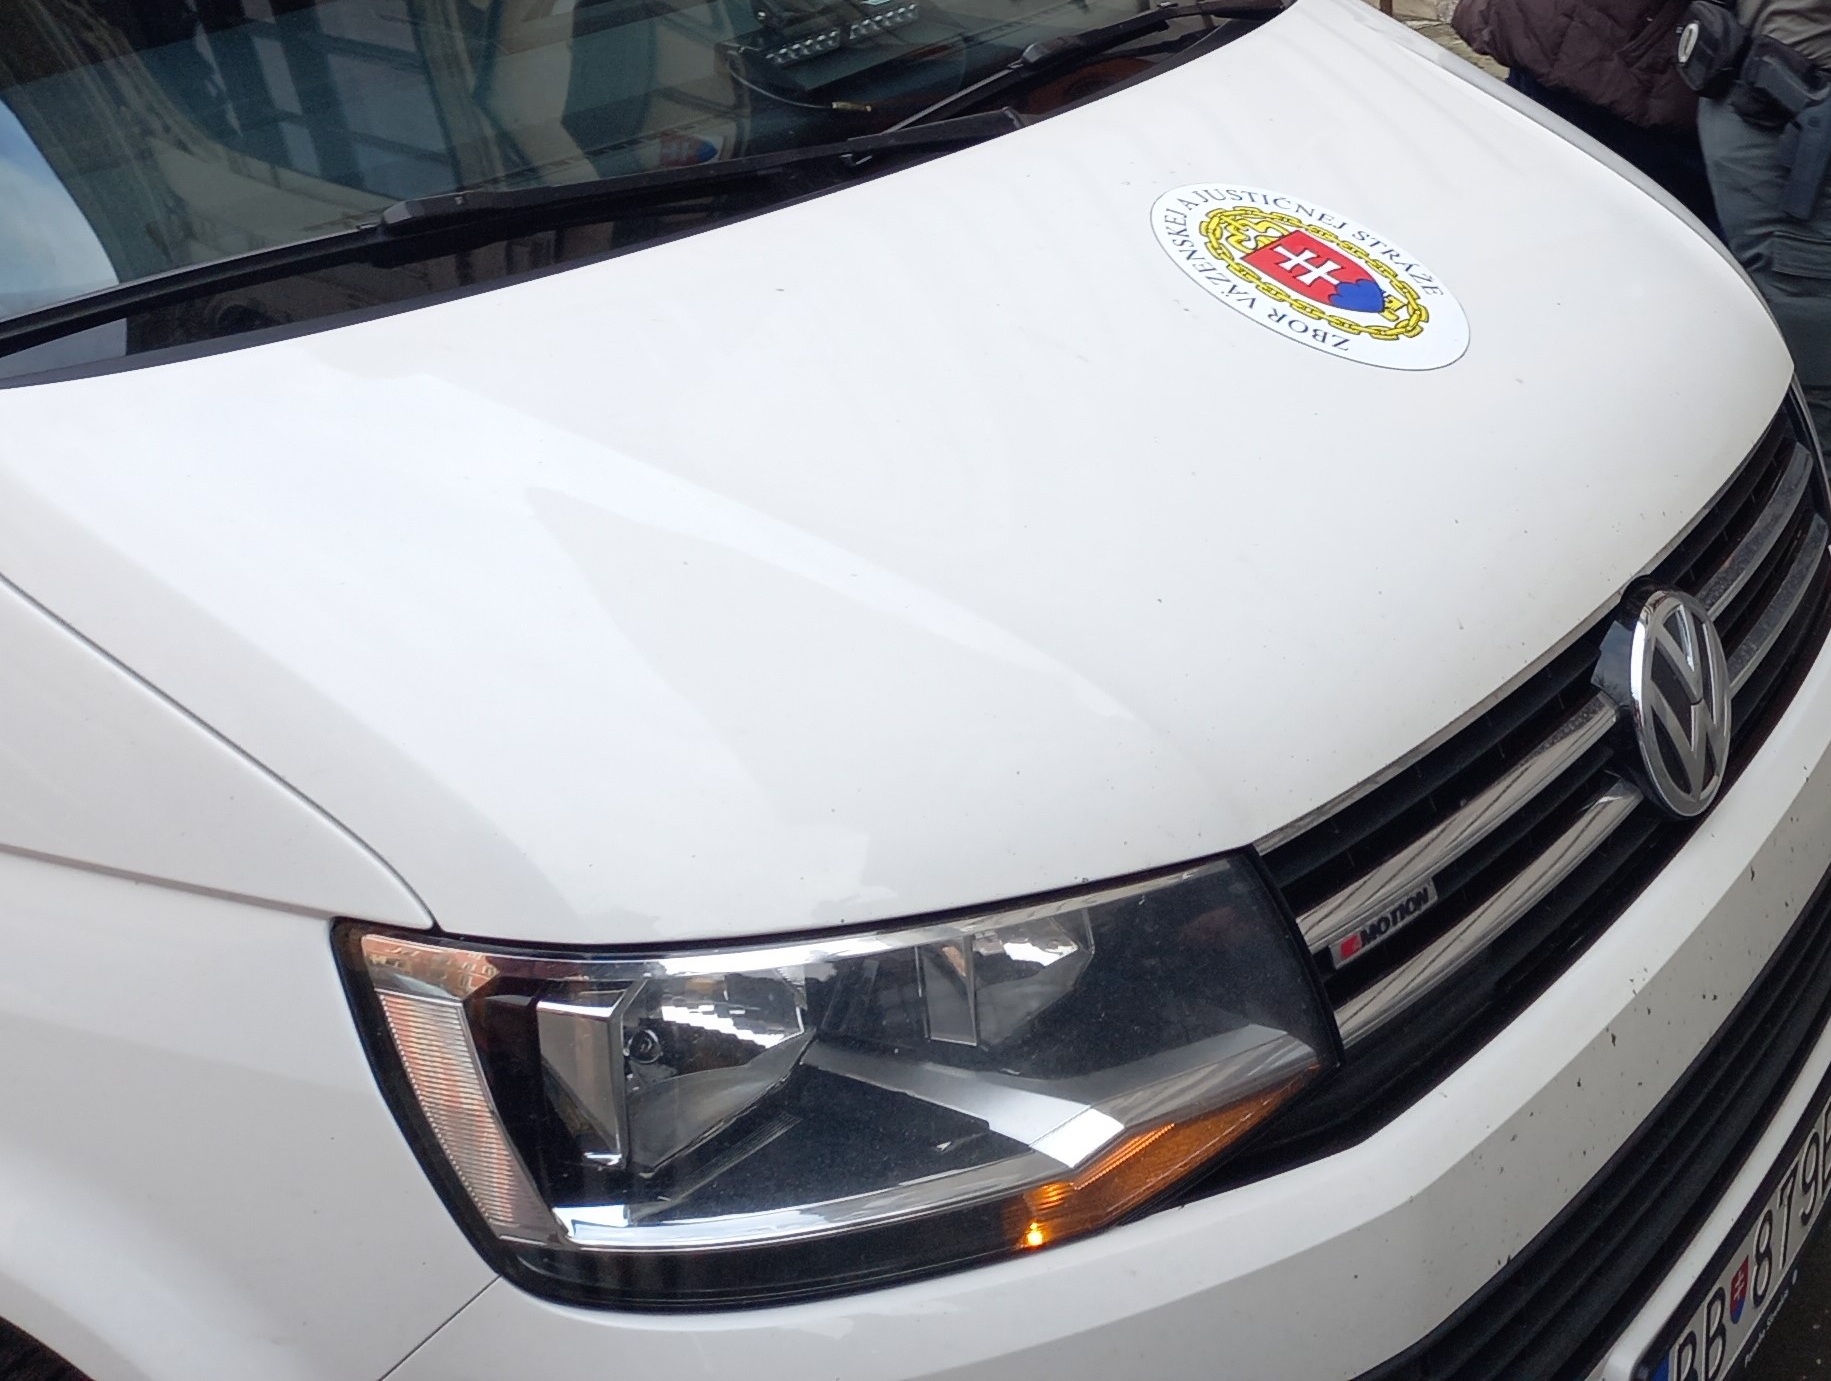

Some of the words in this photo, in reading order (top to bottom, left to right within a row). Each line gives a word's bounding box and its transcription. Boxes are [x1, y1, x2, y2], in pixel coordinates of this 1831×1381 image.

[1177, 198, 1200, 211] A
[1352, 230, 1444, 296] STRÁŽE
[1267, 306, 1351, 352] ZBOR
